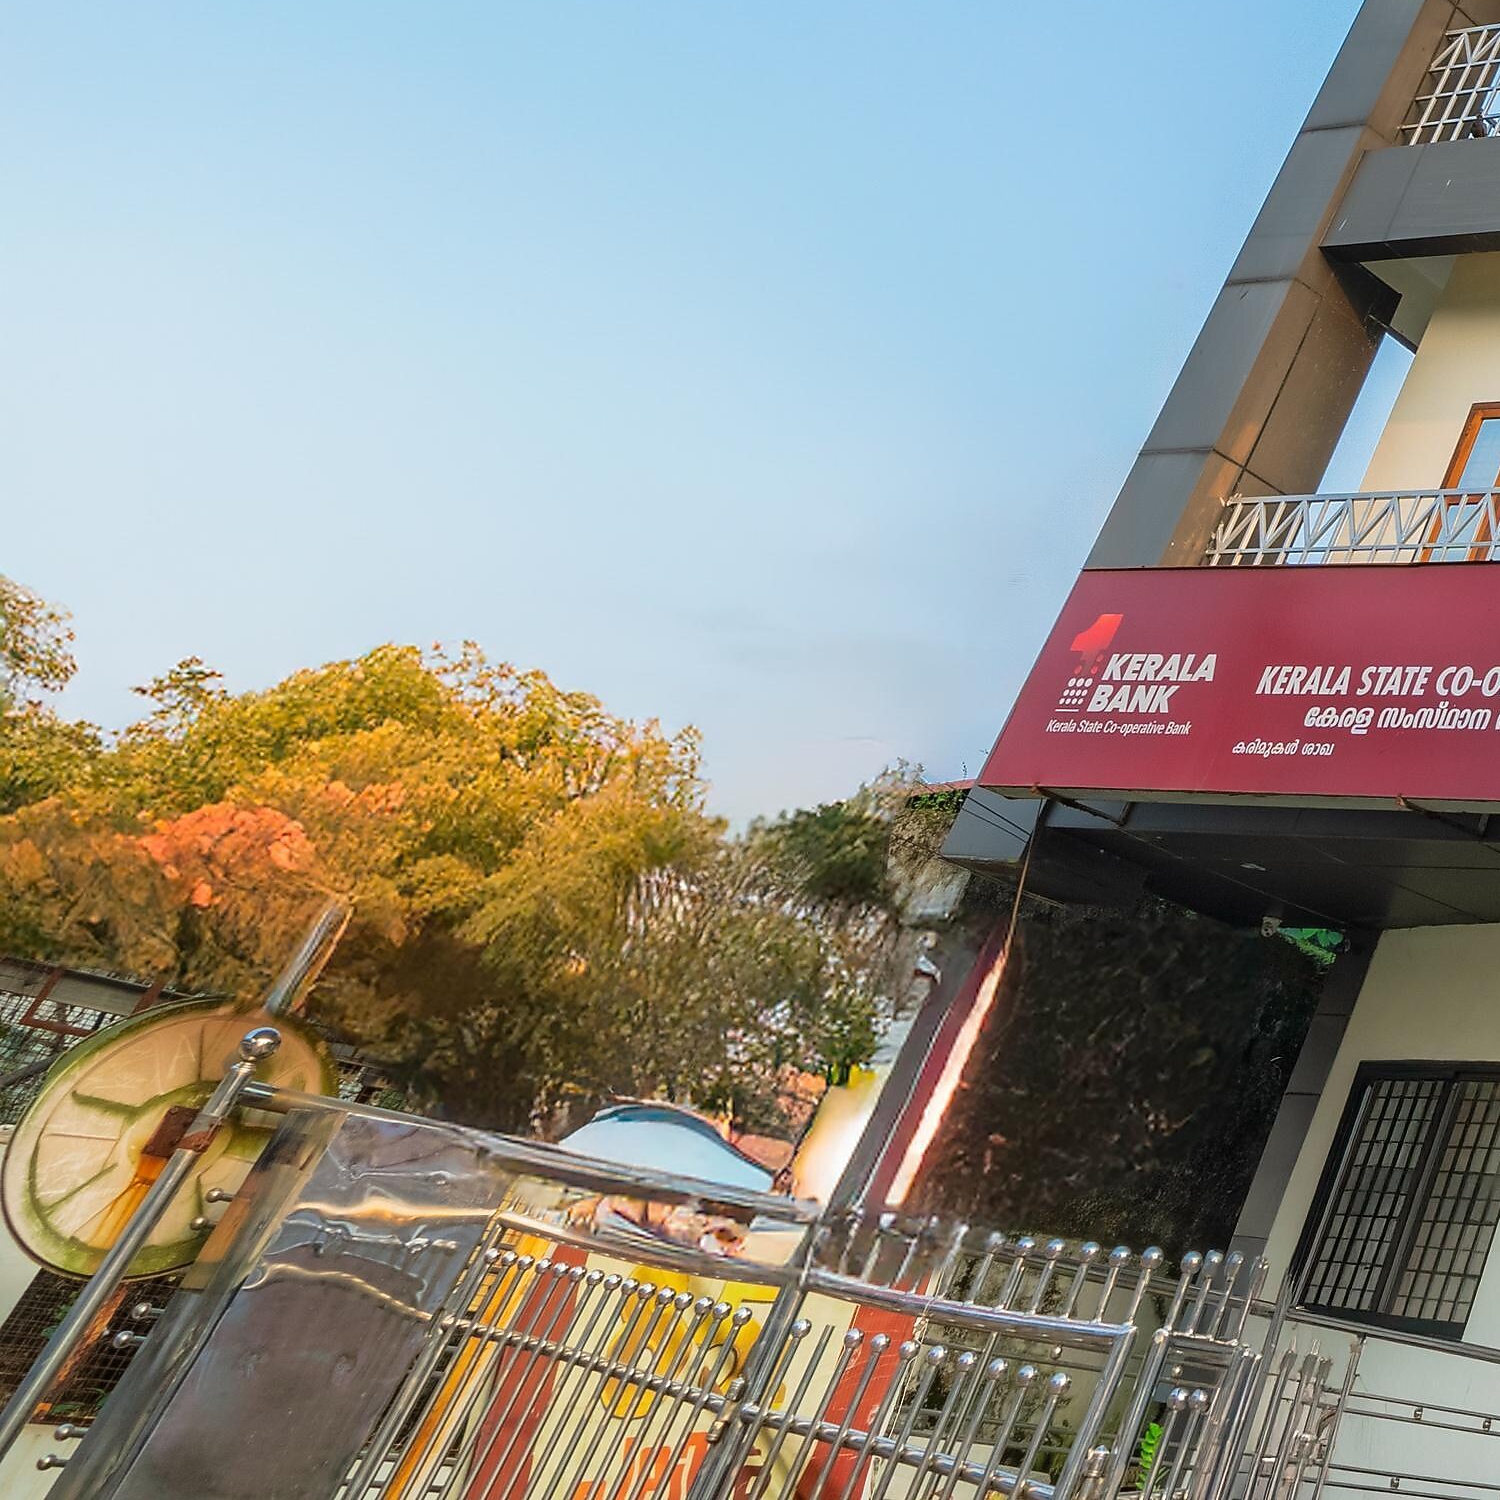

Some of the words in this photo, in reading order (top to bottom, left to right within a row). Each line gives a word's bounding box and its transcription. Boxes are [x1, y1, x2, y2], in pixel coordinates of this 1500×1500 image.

[1101, 653, 1217, 682] KERALA
[1255, 666, 1352, 695] KERALA
[1356, 666, 1433, 696] STATE
[1086, 684, 1181, 714] BANK
[1046, 719, 1076, 733] Kerala
[1076, 719, 1103, 734] State
[1103, 720, 1168, 737] Co-operative
[1164, 721, 1192, 736] Bank
[1303, 706, 1375, 735] കേരള
